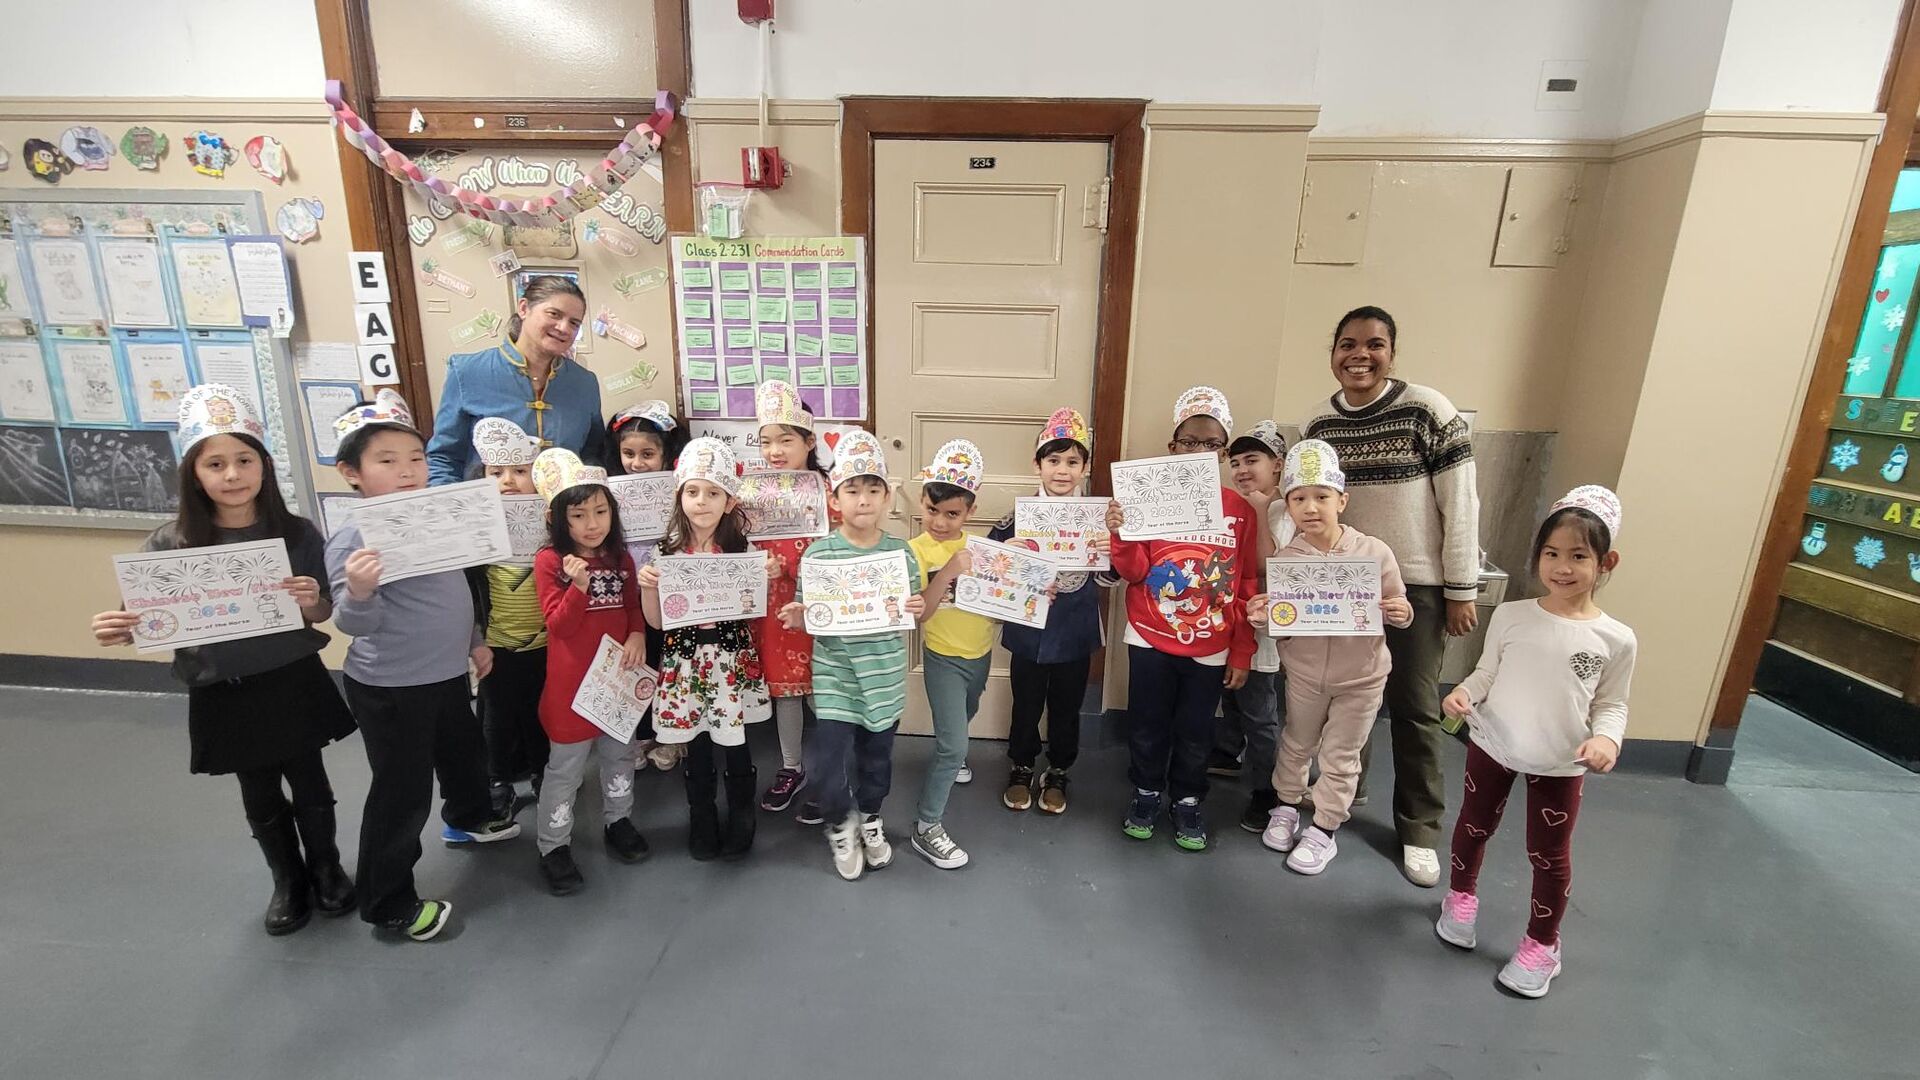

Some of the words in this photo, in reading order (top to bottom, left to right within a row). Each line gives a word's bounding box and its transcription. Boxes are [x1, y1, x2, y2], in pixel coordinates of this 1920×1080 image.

[973, 158, 992, 167] 234
[686, 243, 717, 257] Class
[755, 243, 818, 257] Commendation
[820, 244, 845, 257] Cards
[1151, 505, 1185, 517] 2026
[1058, 529, 1080, 537] New
[1319, 590, 1344, 600] New
[187, 602, 241, 620] 2026
[1304, 603, 1340, 615] 2026
